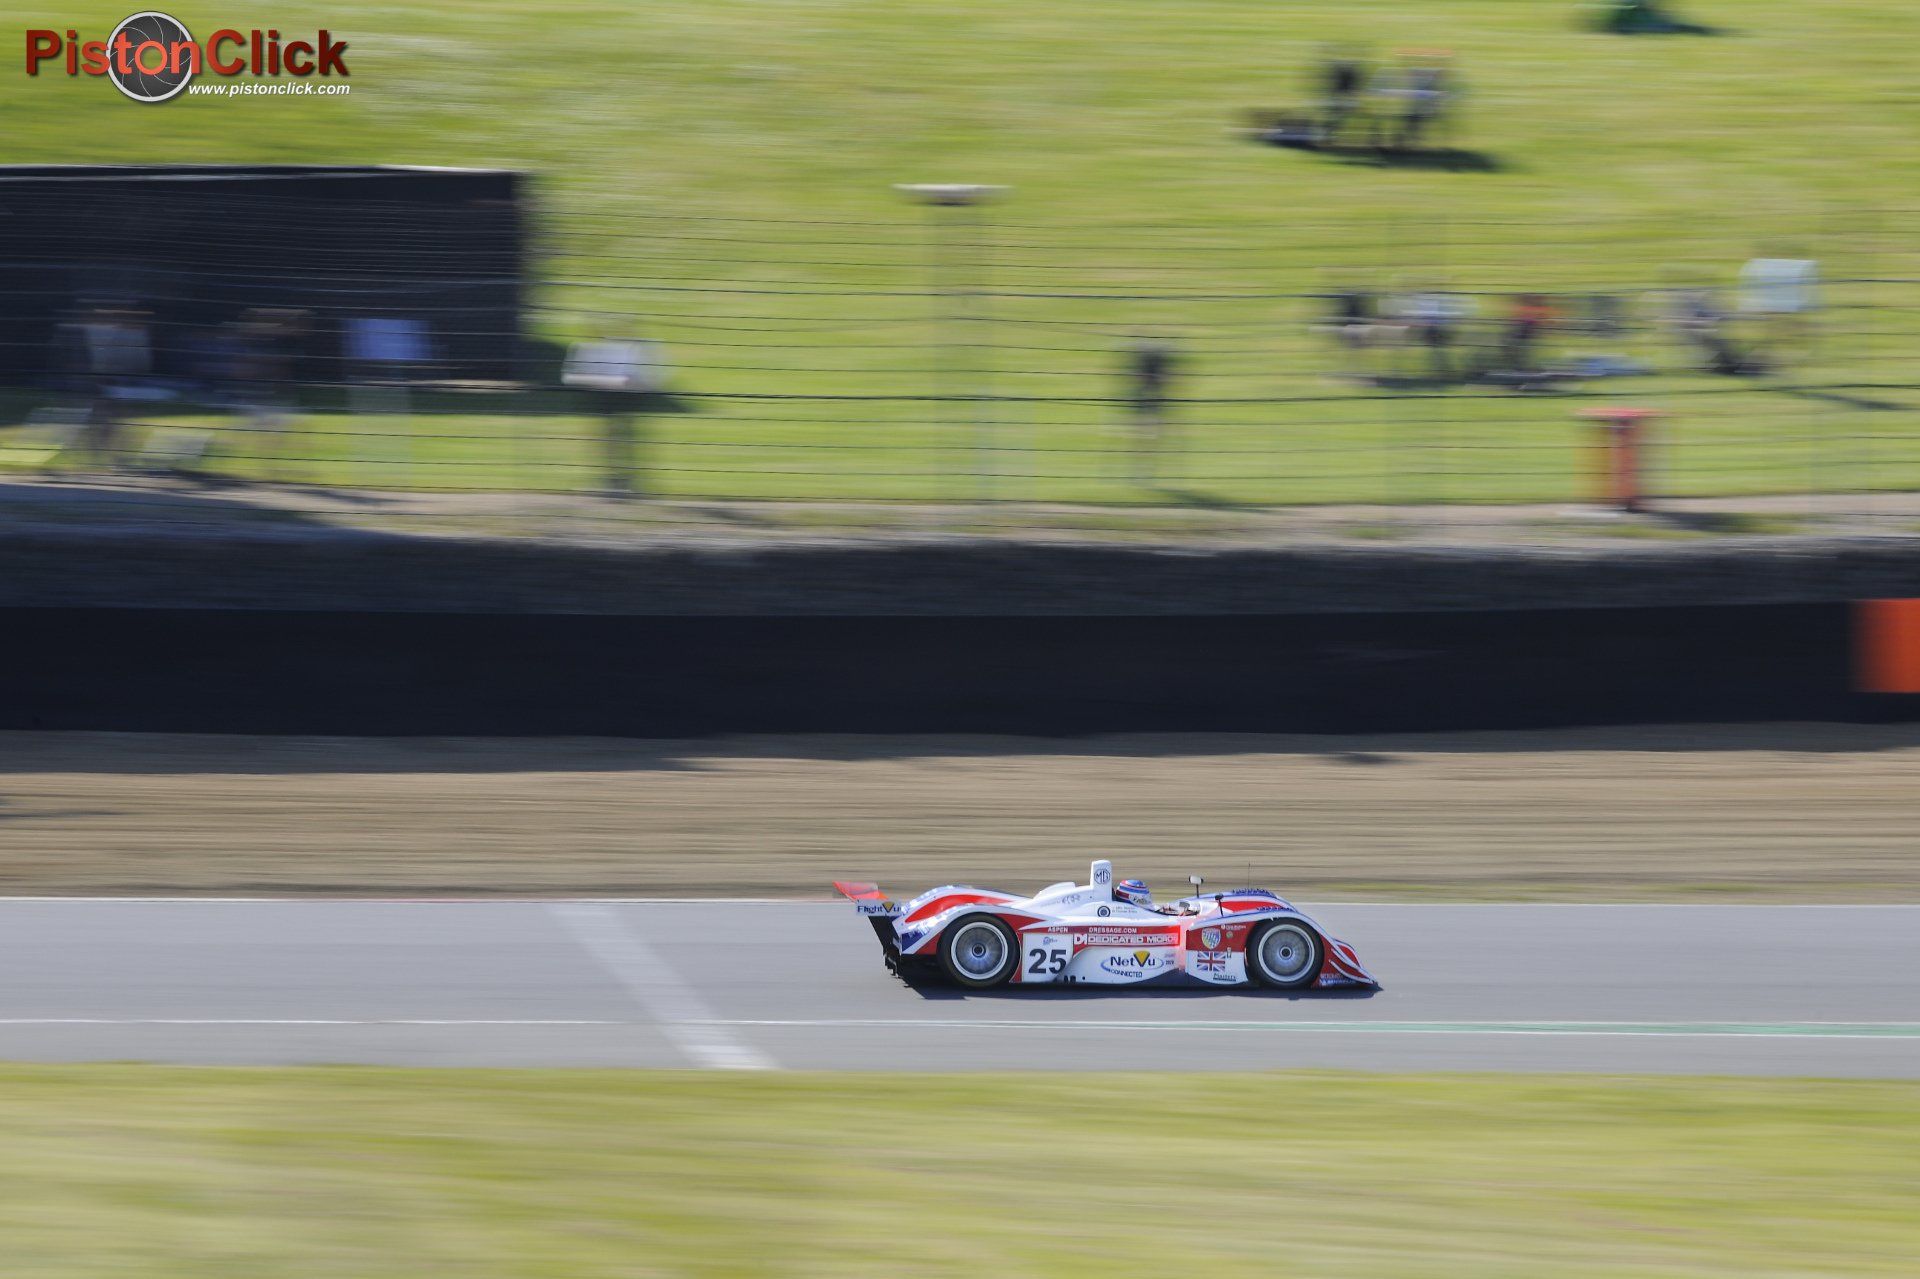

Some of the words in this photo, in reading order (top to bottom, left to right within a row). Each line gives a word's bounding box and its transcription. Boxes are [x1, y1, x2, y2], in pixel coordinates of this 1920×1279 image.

[1095, 869, 1110, 884] MG
[1088, 935, 1143, 944] DEDICATED
[1028, 949, 1067, 974] 25
[1110, 950, 1156, 968] NetVu
[1109, 968, 1143, 978] CONNECTED
